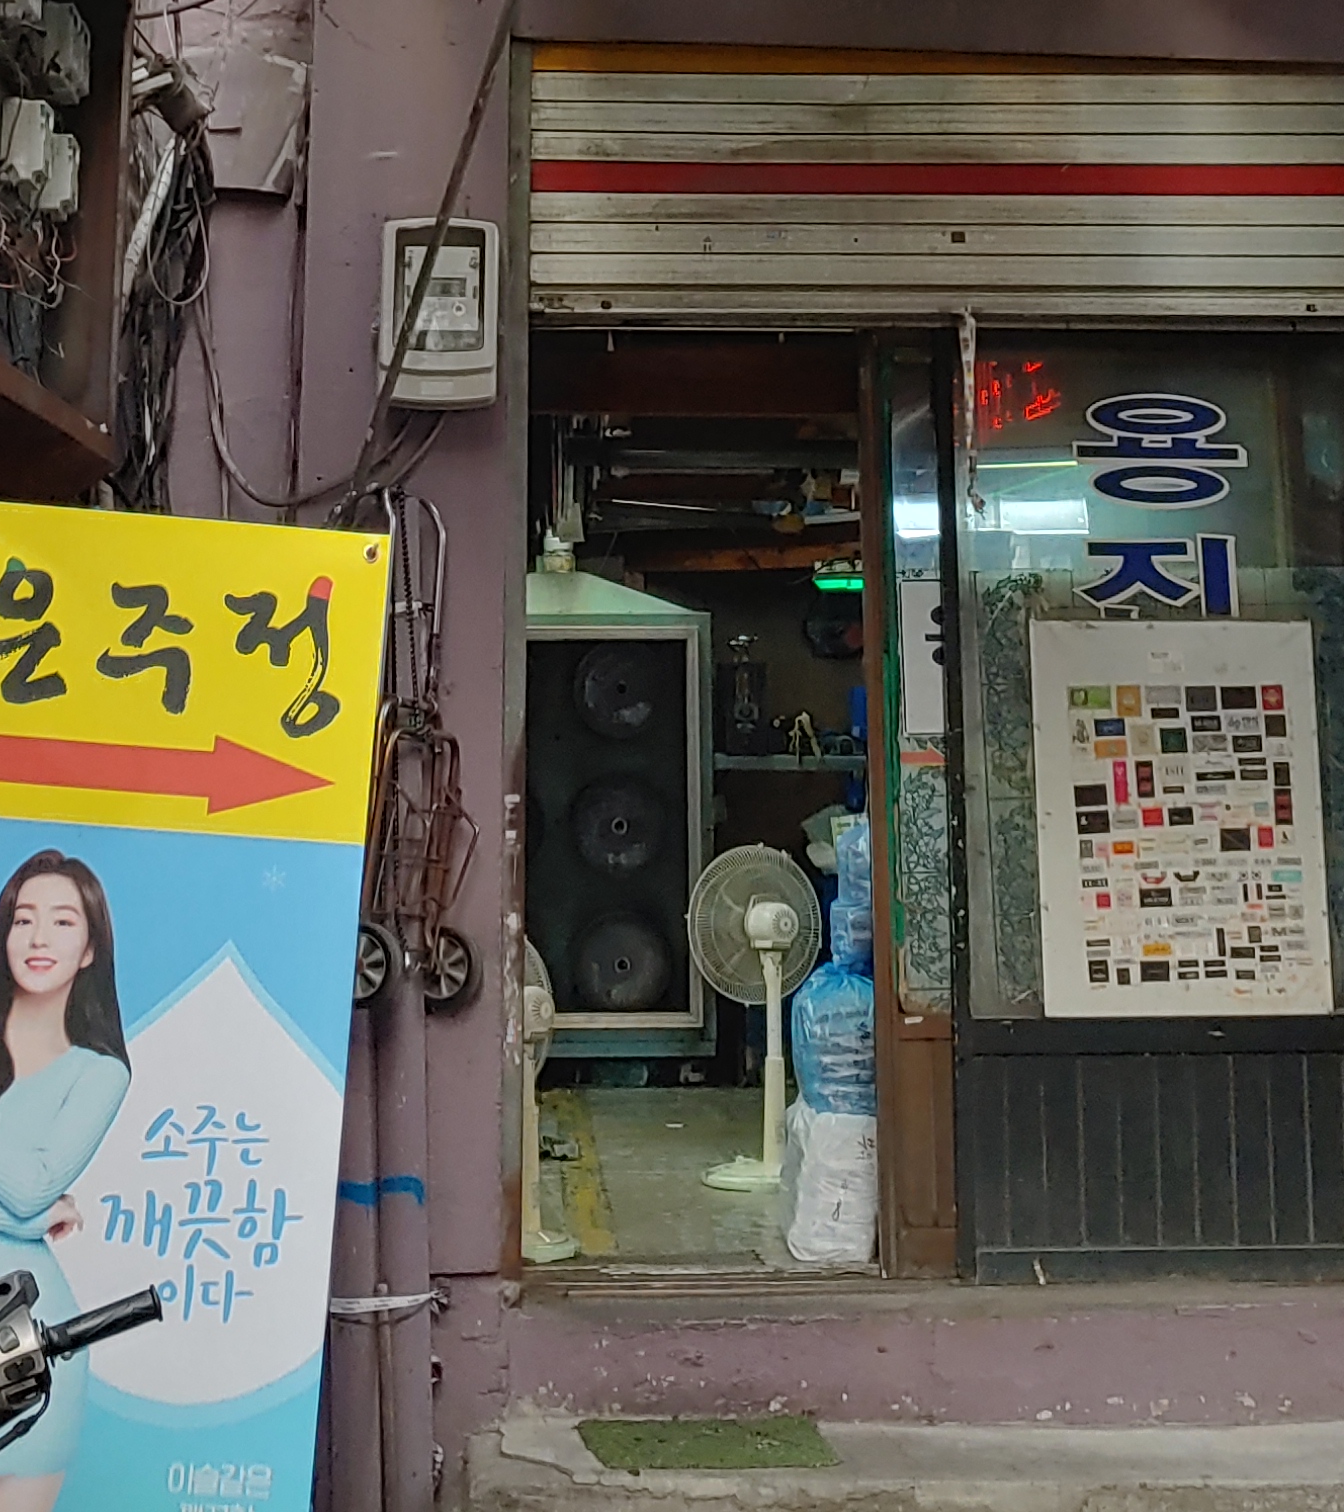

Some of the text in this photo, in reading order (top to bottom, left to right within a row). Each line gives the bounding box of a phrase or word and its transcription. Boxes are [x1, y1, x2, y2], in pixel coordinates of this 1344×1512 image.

[141, 1105, 270, 1177] 소주는
[100, 1178, 304, 1268] 깨끗함
[157, 1264, 254, 1324] 이다
